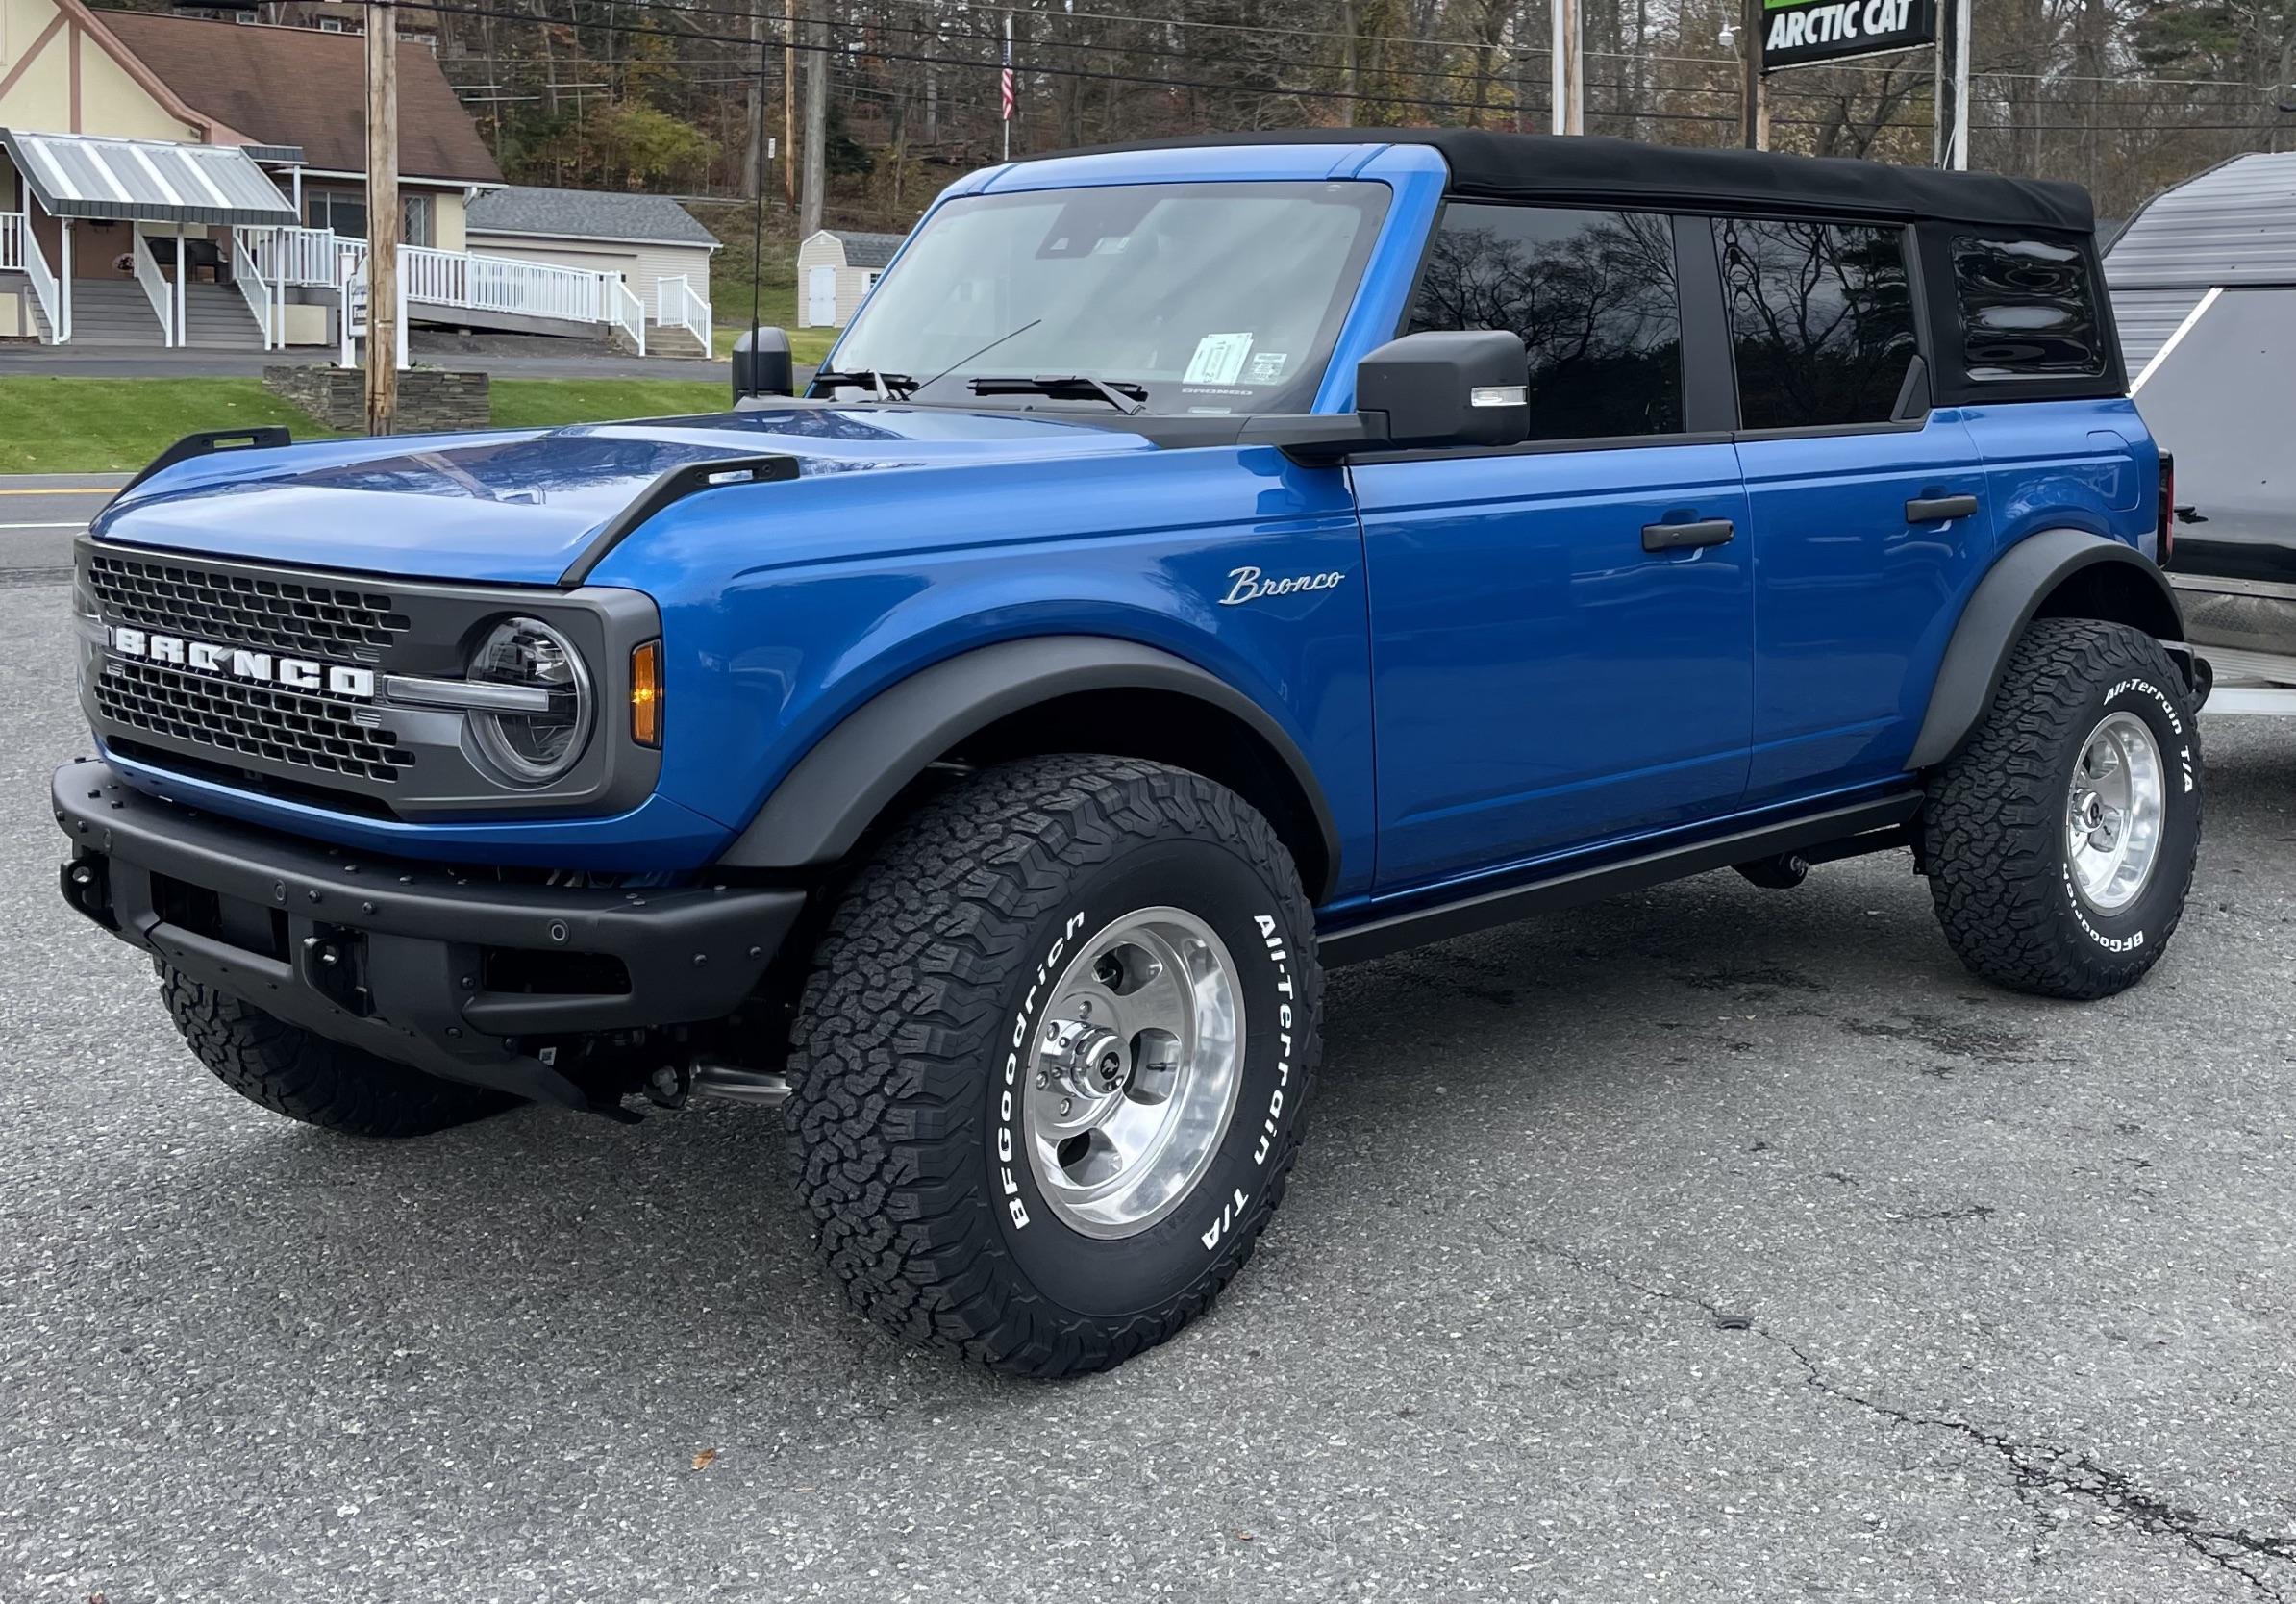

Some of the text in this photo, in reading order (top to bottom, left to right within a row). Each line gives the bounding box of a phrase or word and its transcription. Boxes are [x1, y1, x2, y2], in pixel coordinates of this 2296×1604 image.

[1765, 0, 1913, 51] ARCTIC CAT
[1218, 565, 1345, 605] Bronco
[115, 627, 374, 697] BRONCO
[2103, 677, 2194, 793] All-Terrain T/A
[2062, 862, 2144, 953] BFGoodrich
[997, 910, 1086, 1230] BFGoodrich
[1200, 914, 1294, 1251] All-Terrain T/A
